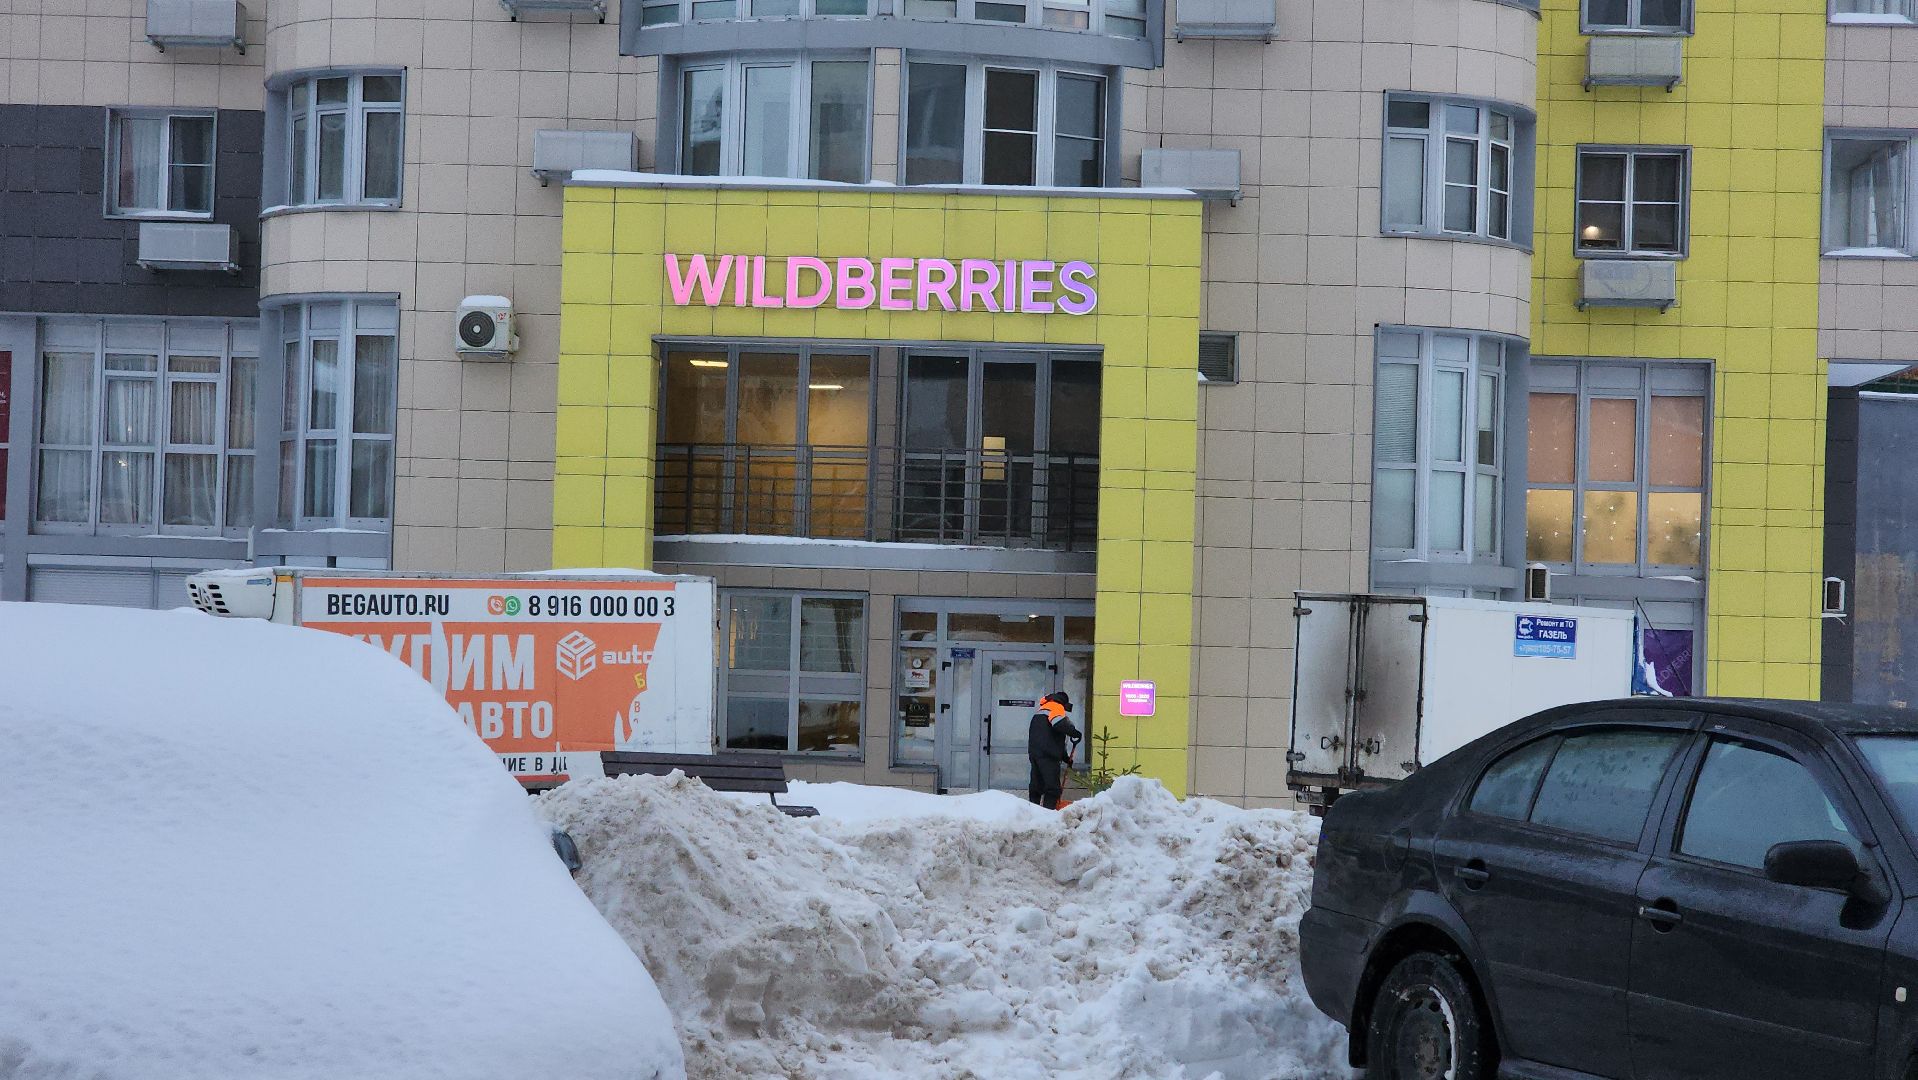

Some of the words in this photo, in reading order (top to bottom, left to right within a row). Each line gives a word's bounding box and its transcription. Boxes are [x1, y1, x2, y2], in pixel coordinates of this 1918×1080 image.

[663, 253, 1098, 316] WILDBERRIES
[327, 593, 450, 616] BEGAUTO.RU
[528, 595, 541, 615] 8
[547, 595, 582, 617] 916
[590, 596, 629, 617] 000
[633, 596, 659, 617] 00
[663, 596, 675, 617] 3
[1536, 618, 1560, 628] Ремонт
[1538, 629, 1568, 640] ГАЗЕЛЬ
[456, 701, 554, 739] АВТО
[534, 757, 543, 772] В
